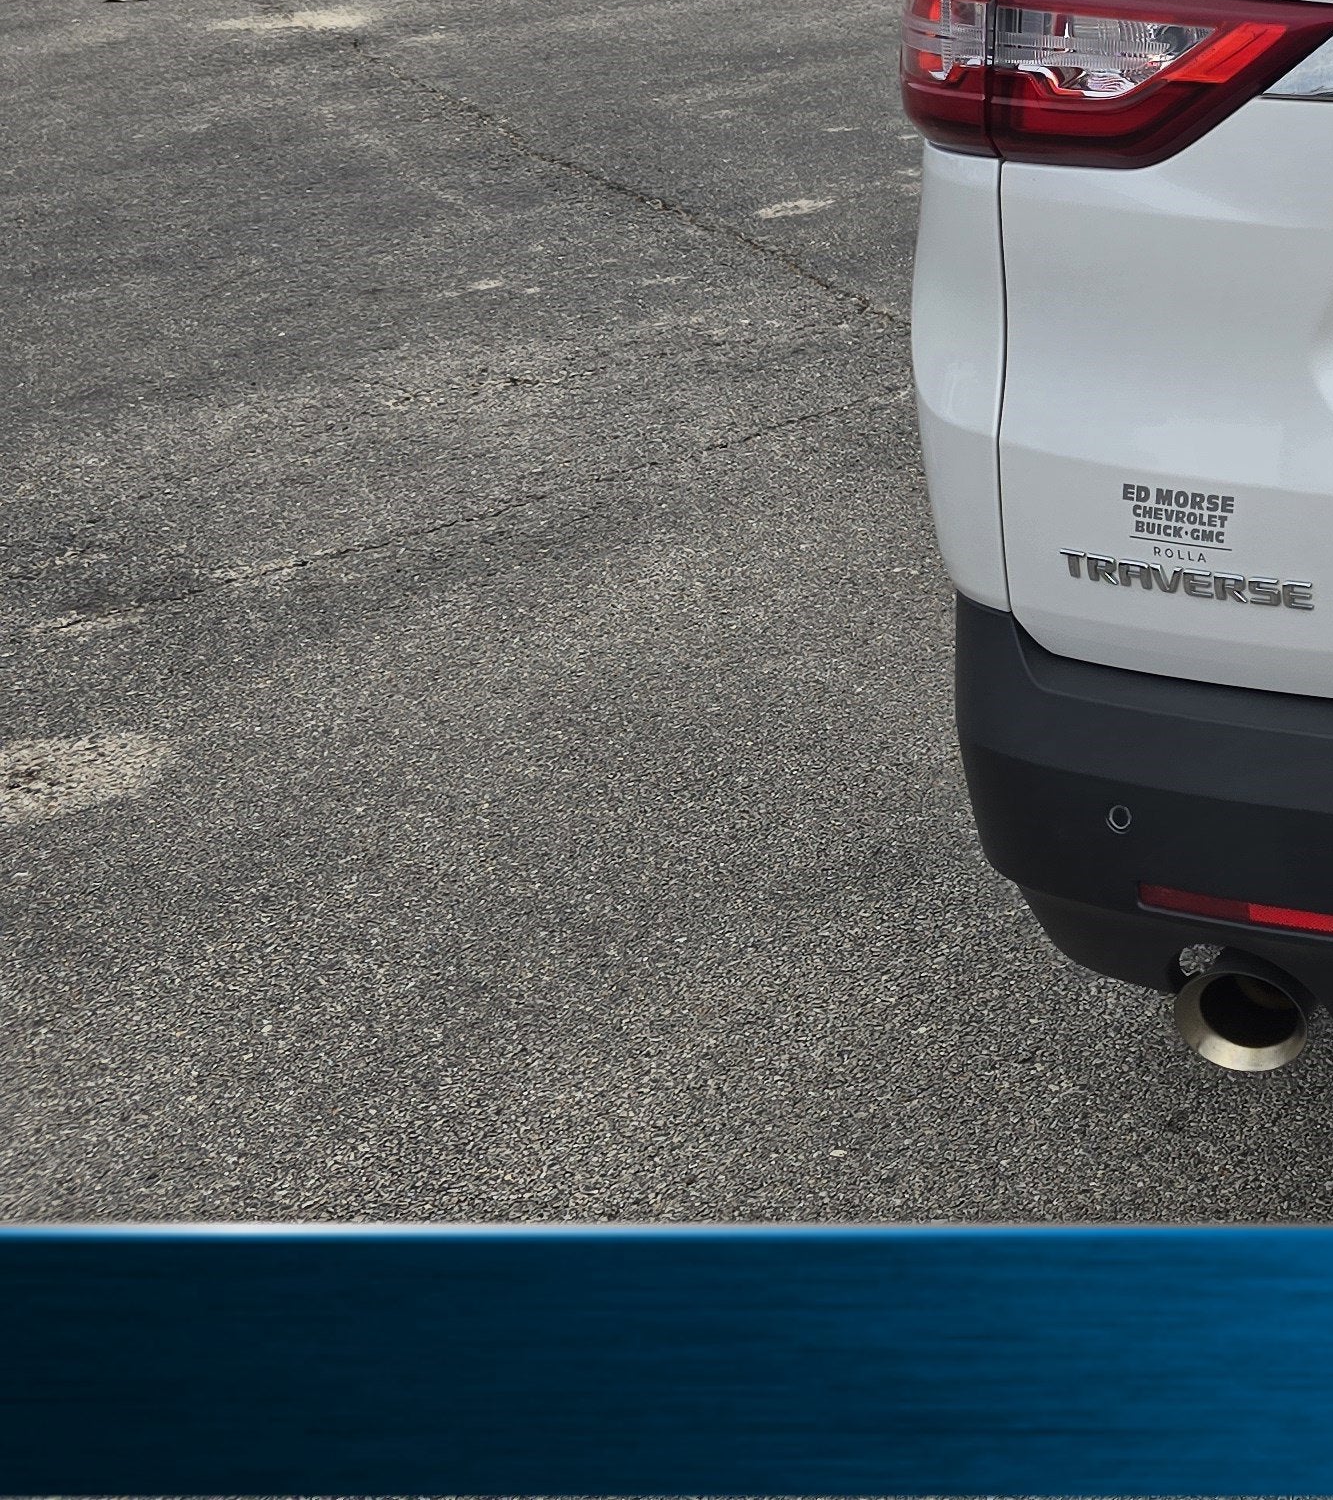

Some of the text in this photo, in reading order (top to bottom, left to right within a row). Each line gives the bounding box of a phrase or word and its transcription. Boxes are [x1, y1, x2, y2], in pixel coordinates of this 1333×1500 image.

[1122, 483, 1235, 514] ED MORSE
[1132, 504, 1228, 528] CHEVROLET
[1153, 546, 1207, 563] ROLLA
[1059, 548, 1314, 611] TRAVERSE
